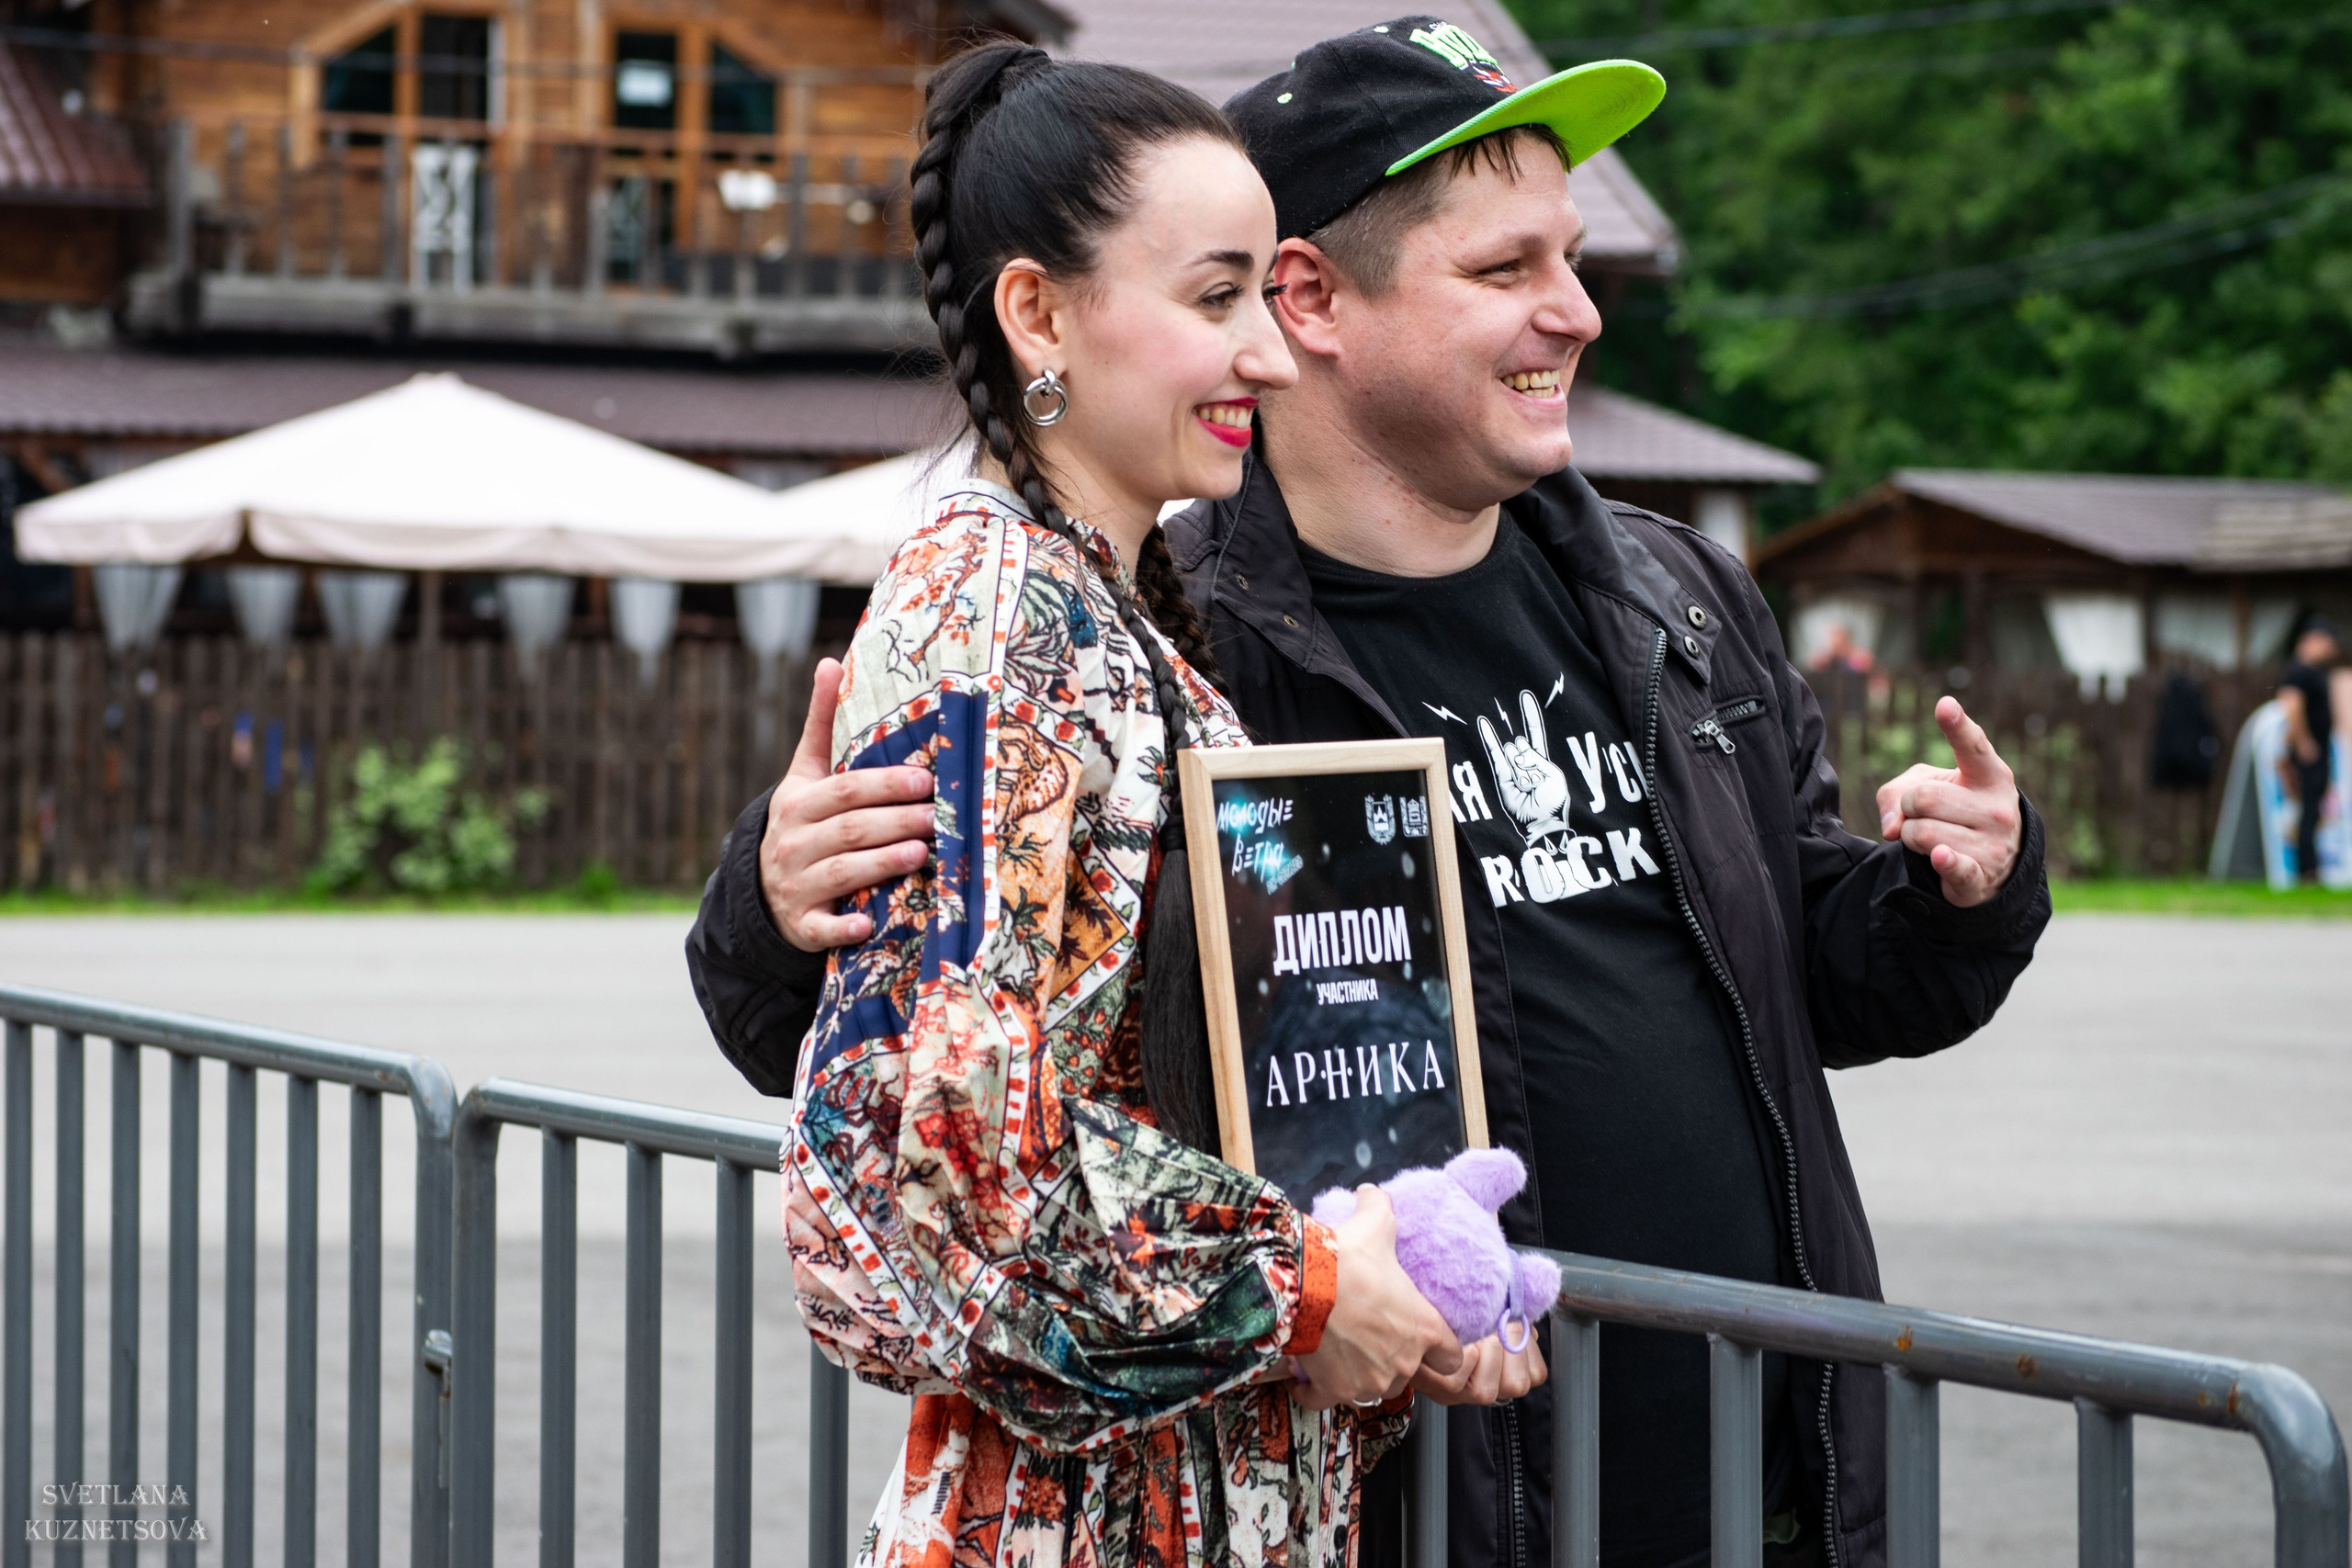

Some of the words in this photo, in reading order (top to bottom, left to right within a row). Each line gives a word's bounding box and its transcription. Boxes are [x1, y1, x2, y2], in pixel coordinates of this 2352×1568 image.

[1480, 827, 1661, 908] ROCK
[1272, 906, 1412, 976] ДИПЛОМ
[1316, 978, 1379, 1006] УЧАСТНИКА
